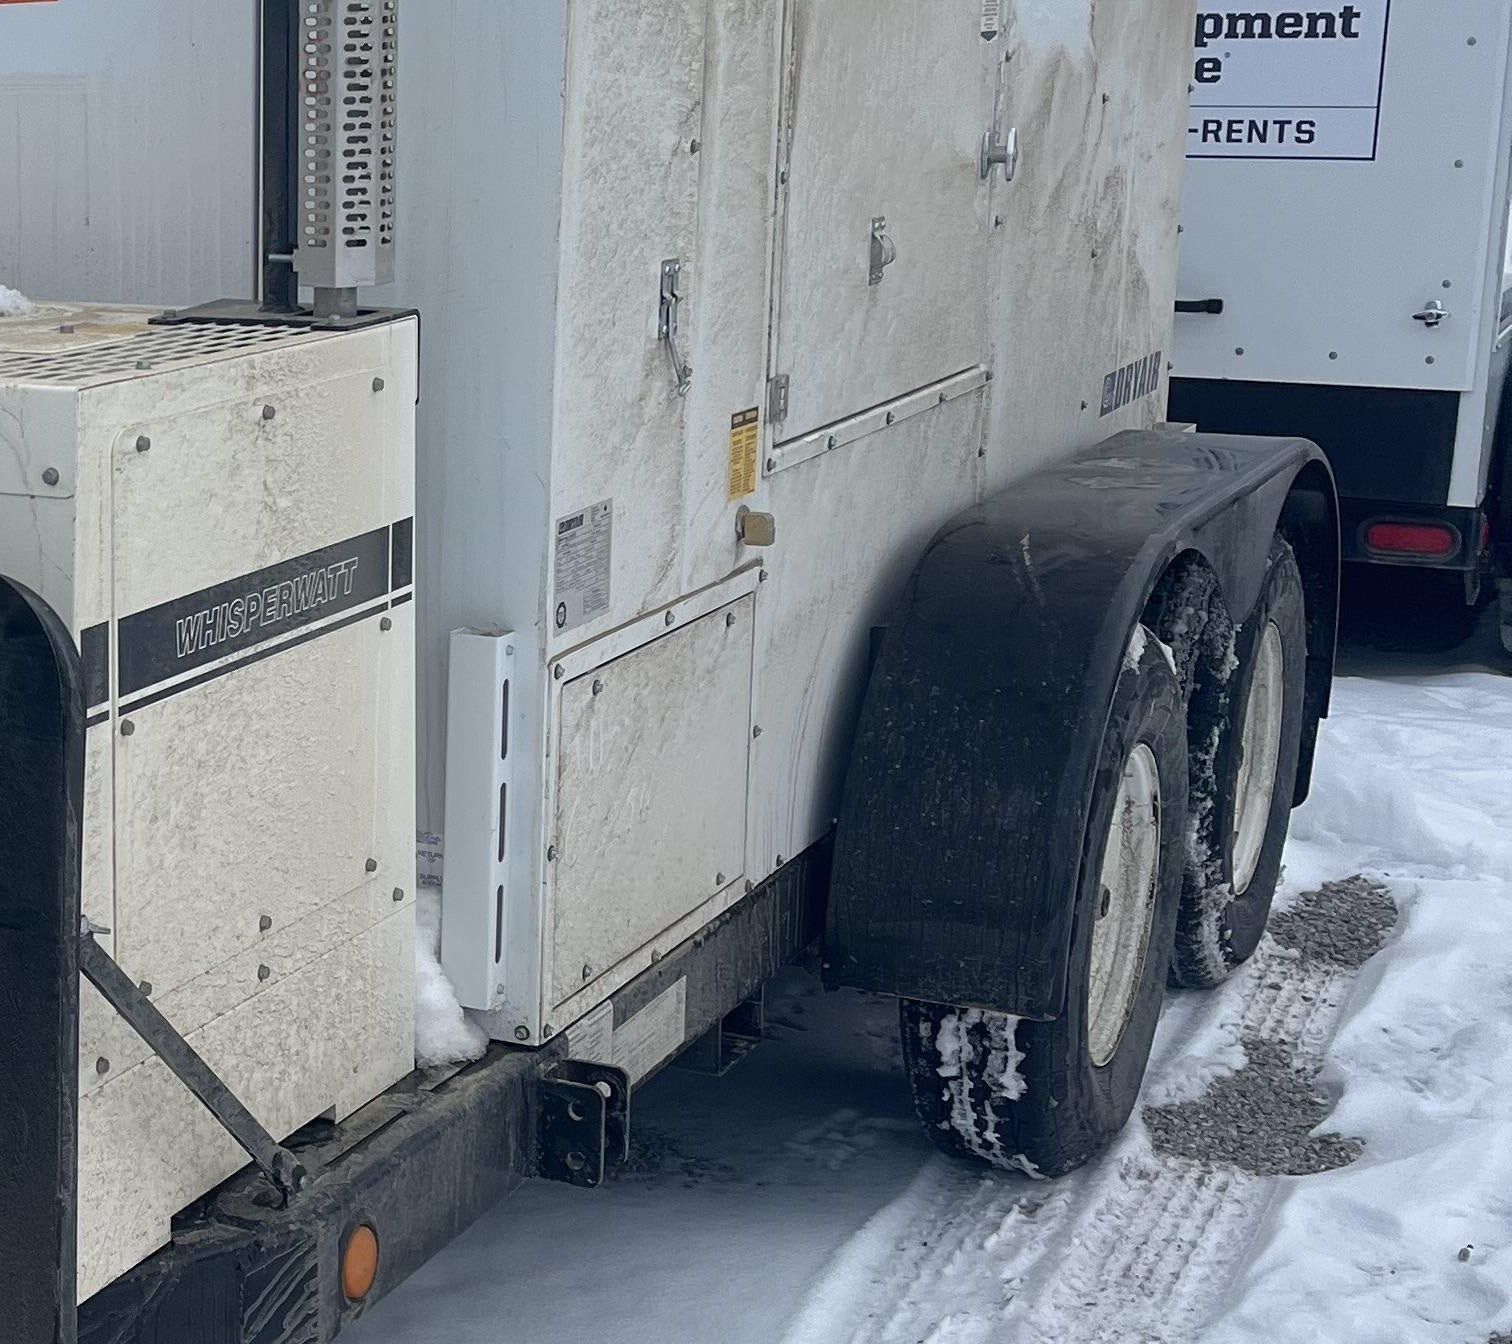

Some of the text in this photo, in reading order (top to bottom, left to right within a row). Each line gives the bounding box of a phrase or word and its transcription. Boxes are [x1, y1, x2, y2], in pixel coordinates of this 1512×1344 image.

[1194, 5, 1361, 48] pment
[1113, 350, 1162, 411] DRYAIR
[176, 556, 359, 658] WHISPERWATT
